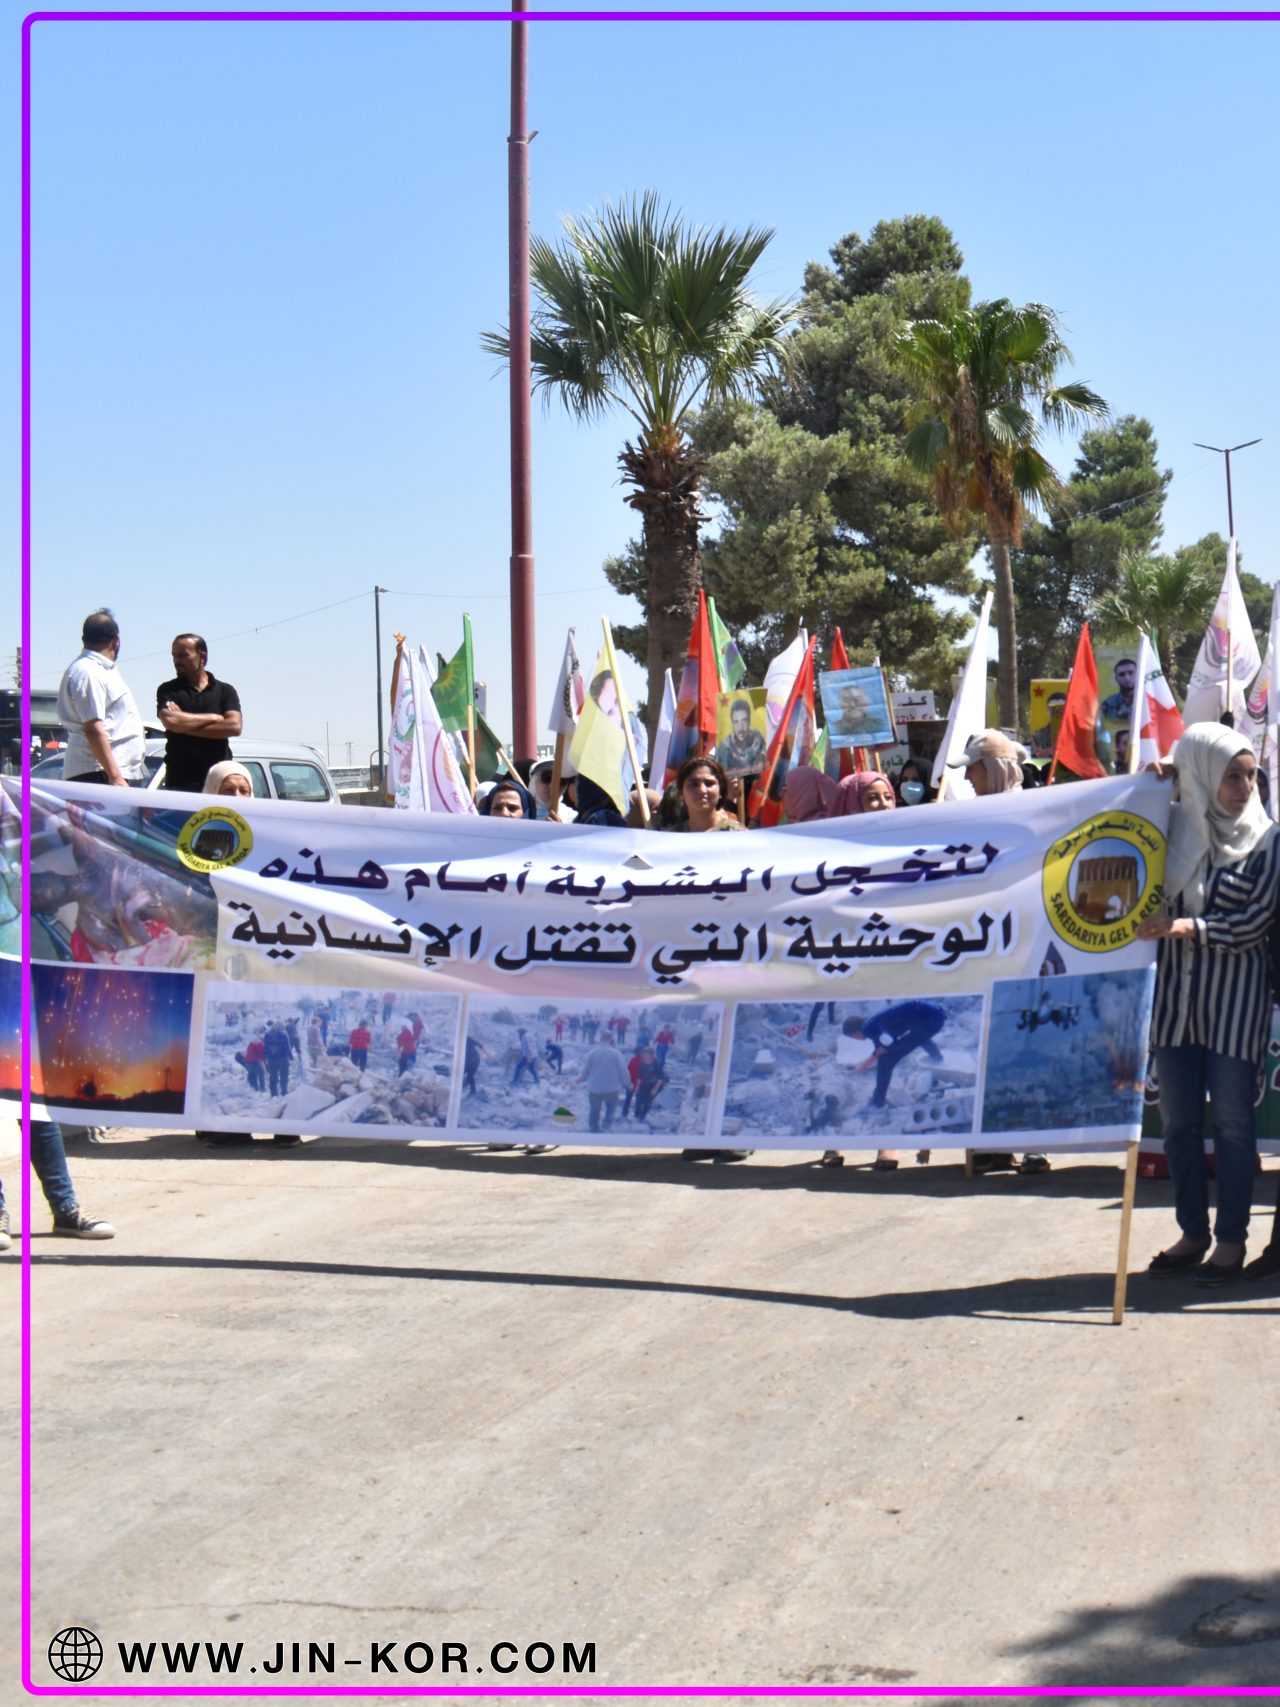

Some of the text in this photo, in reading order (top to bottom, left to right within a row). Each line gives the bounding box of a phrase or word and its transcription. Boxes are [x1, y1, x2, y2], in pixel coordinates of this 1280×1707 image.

[258, 842, 1000, 906] لتخجل البشرية أمام هذه
[226, 900, 1012, 985] الوحشية التي تقتل الإنسانية
[1109, 926, 1130, 945] GEL
